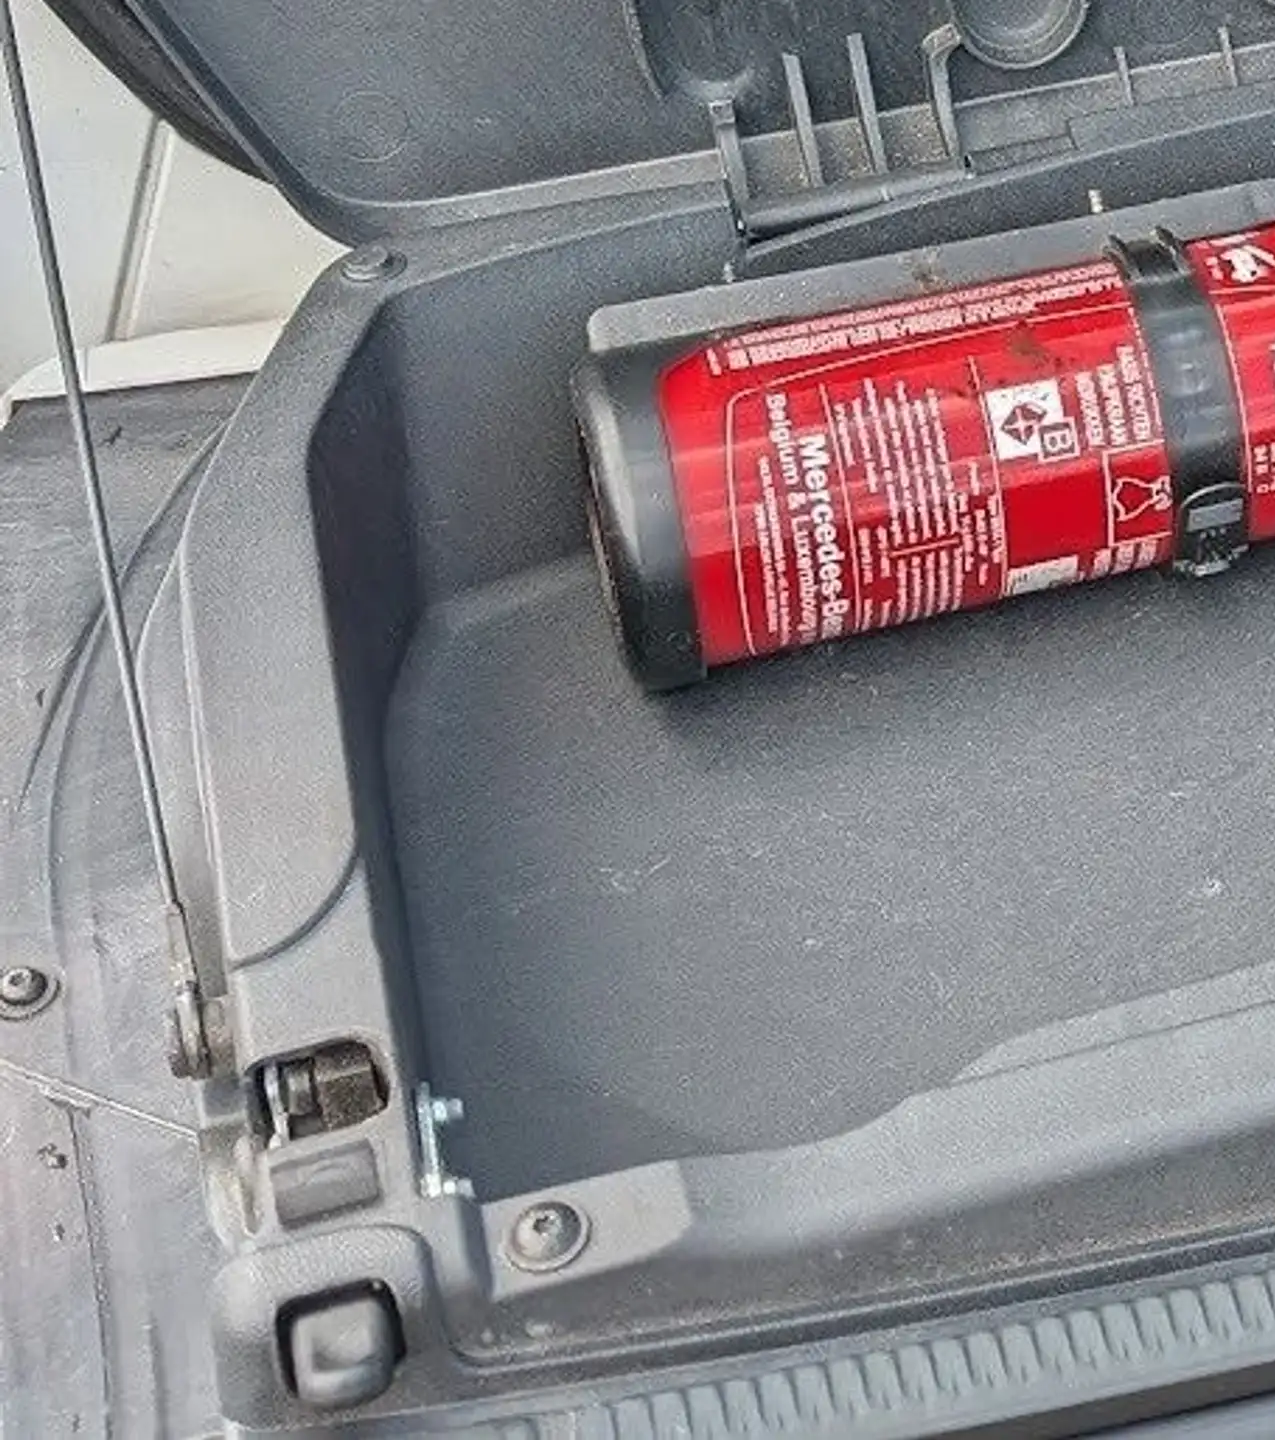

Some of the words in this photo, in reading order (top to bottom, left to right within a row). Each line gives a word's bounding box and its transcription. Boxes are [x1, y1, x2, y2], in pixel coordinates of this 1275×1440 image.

[765, 392, 799, 486] Belgium
[787, 491, 807, 511] &
[790, 515, 820, 633] Luxembourg
